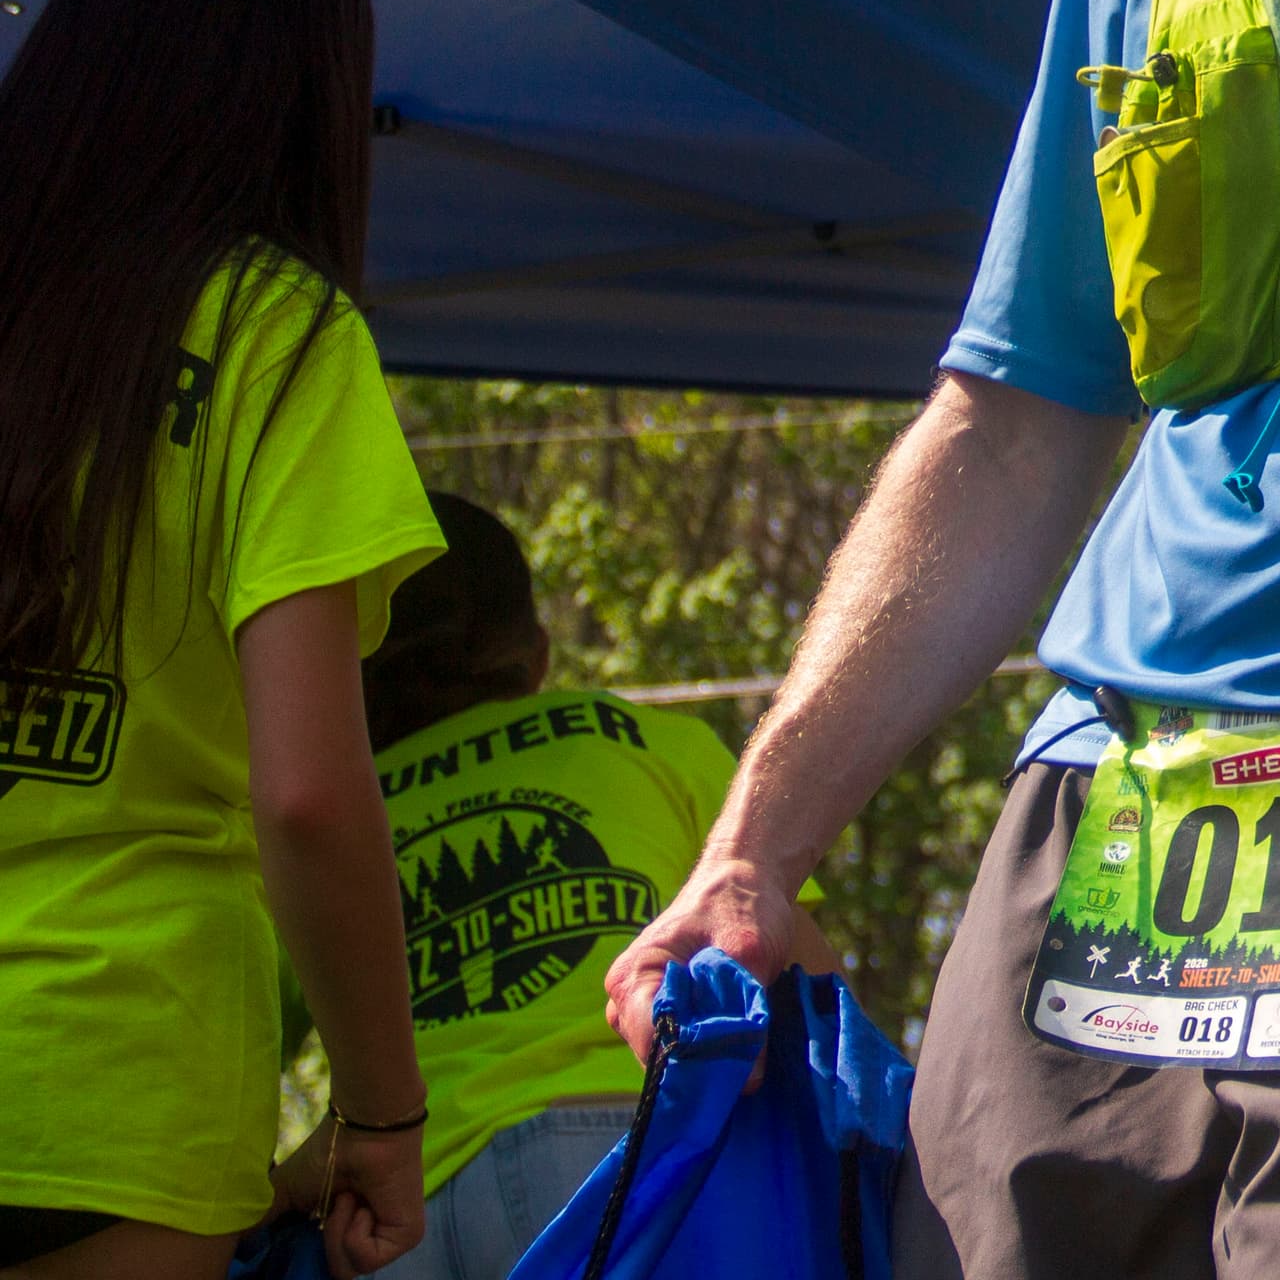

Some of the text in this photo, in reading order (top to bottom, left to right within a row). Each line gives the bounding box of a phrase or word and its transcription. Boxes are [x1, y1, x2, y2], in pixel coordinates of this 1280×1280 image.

[0, 684, 106, 763] ETZ
[446, 789, 502, 818] FREE
[1099, 862, 1126, 875] MOORE
[400, 877, 651, 991] Z-TO-SHEETZ
[1184, 958, 1208, 969] 2026
[502, 954, 573, 1011] RUN
[1184, 999, 1239, 1012] BAG CHECK
[1093, 1014, 1159, 1034] Bayside
[1179, 1016, 1234, 1043] 018
